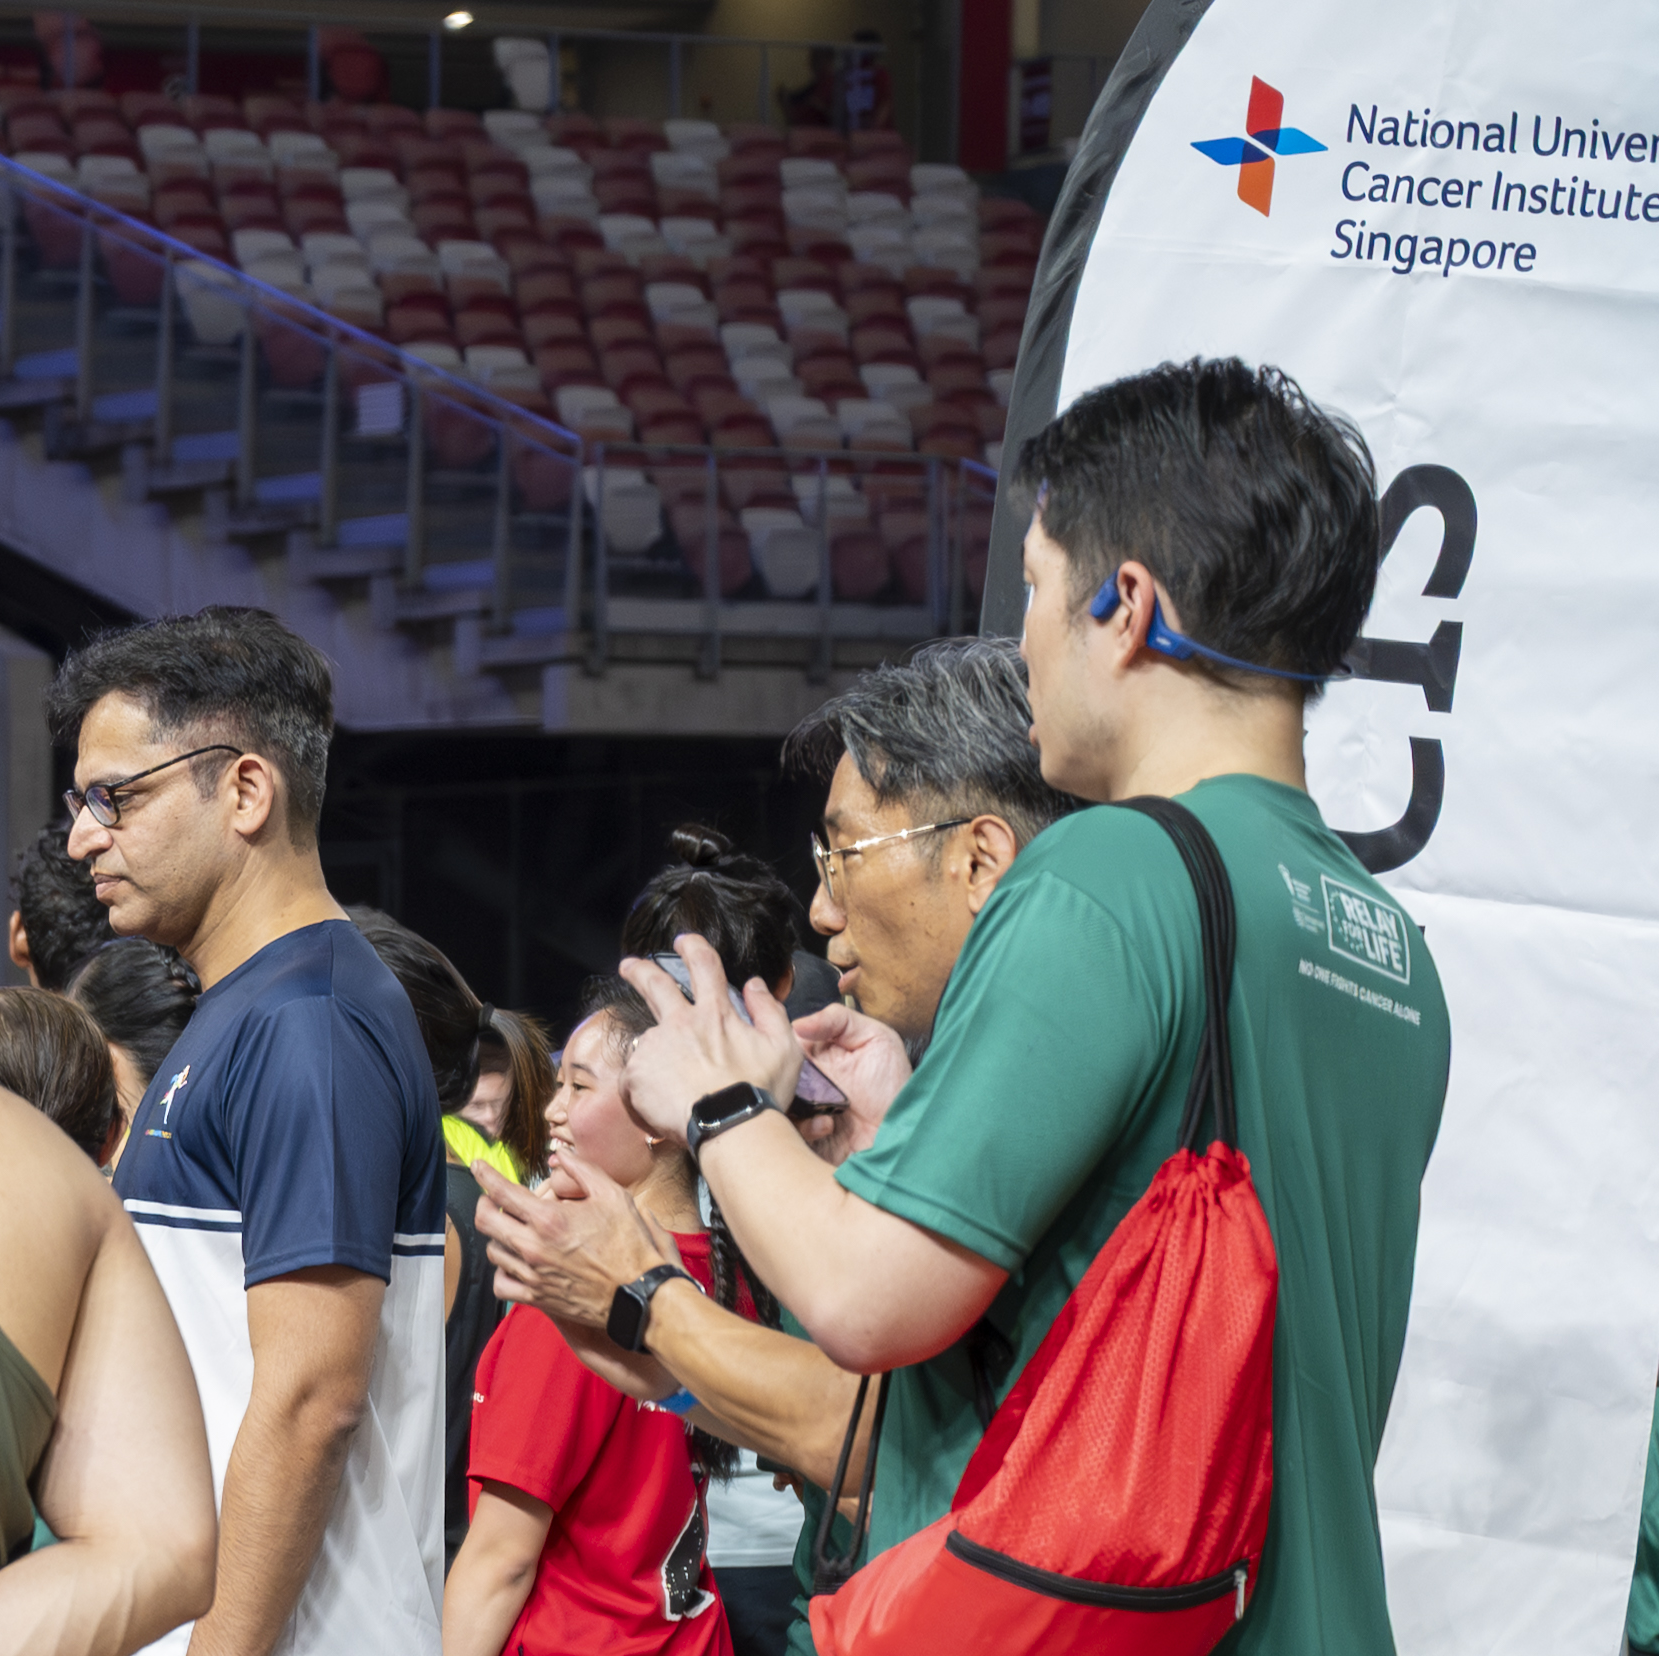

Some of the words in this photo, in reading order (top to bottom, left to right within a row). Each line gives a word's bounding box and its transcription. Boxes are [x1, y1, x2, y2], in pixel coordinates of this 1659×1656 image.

[1346, 103, 1518, 154] National
[1341, 160, 1482, 208] Cancer
[1491, 171, 1659, 223] Institute
[1330, 218, 1537, 278] Singapore
[1340, 892, 1399, 941] RELAY
[1362, 928, 1404, 974] LIFE
